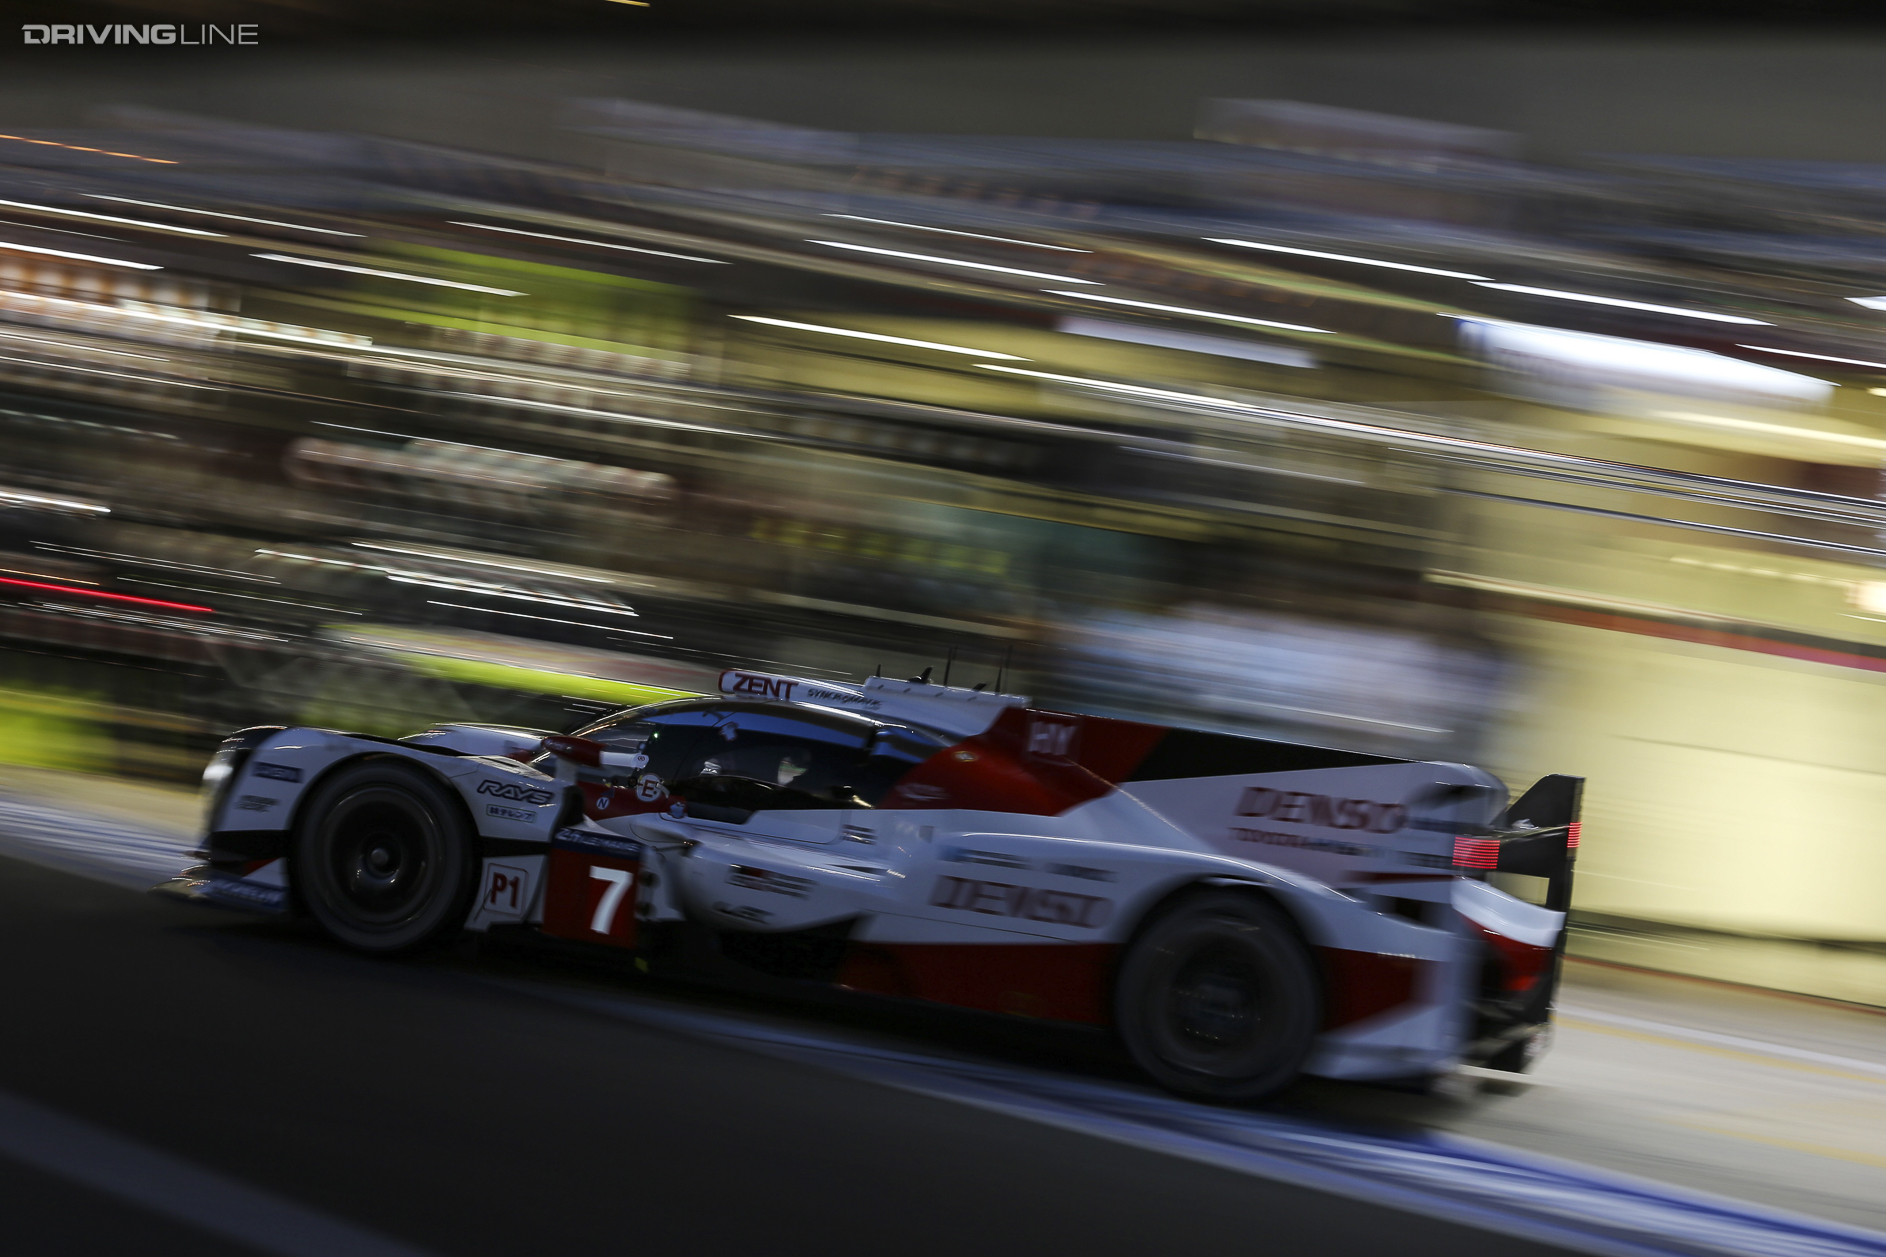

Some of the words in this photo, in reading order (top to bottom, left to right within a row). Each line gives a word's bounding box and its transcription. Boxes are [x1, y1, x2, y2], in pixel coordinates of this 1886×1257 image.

[733, 672, 799, 699] ZENT
[477, 779, 555, 805] RAYS
[598, 798, 608, 808] N
[641, 779, 658, 798] E
[1233, 786, 1409, 834] DENSO
[490, 871, 521, 908] P1
[588, 865, 635, 936] 7
[928, 874, 1116, 929] DENSO
